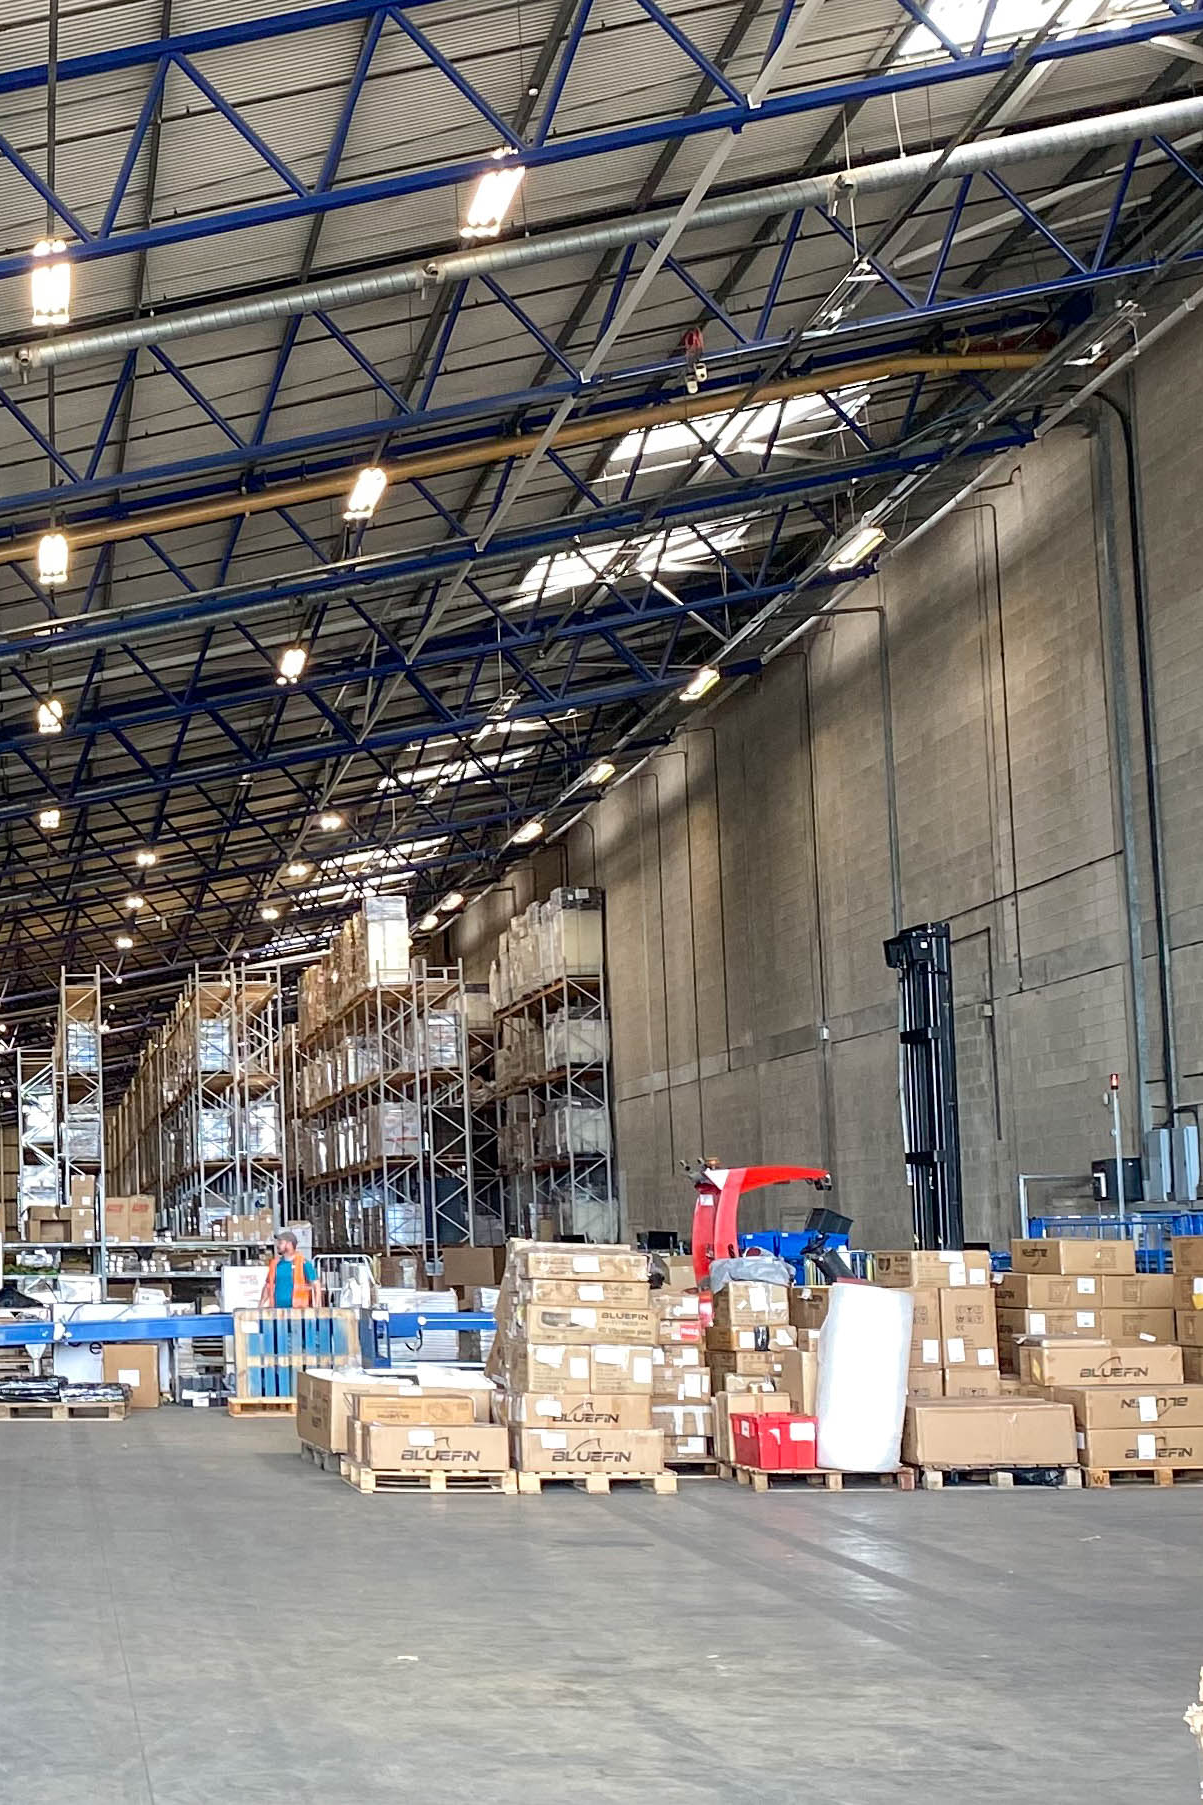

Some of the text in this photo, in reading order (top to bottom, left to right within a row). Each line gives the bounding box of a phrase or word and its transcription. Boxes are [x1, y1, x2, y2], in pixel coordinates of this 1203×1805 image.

[601, 1312, 649, 1321] BLUEFIN
[401, 1449, 481, 1462] BLUEFIN
[552, 1451, 632, 1463] BLUEFIN
[1125, 1447, 1193, 1459] BEFIN
